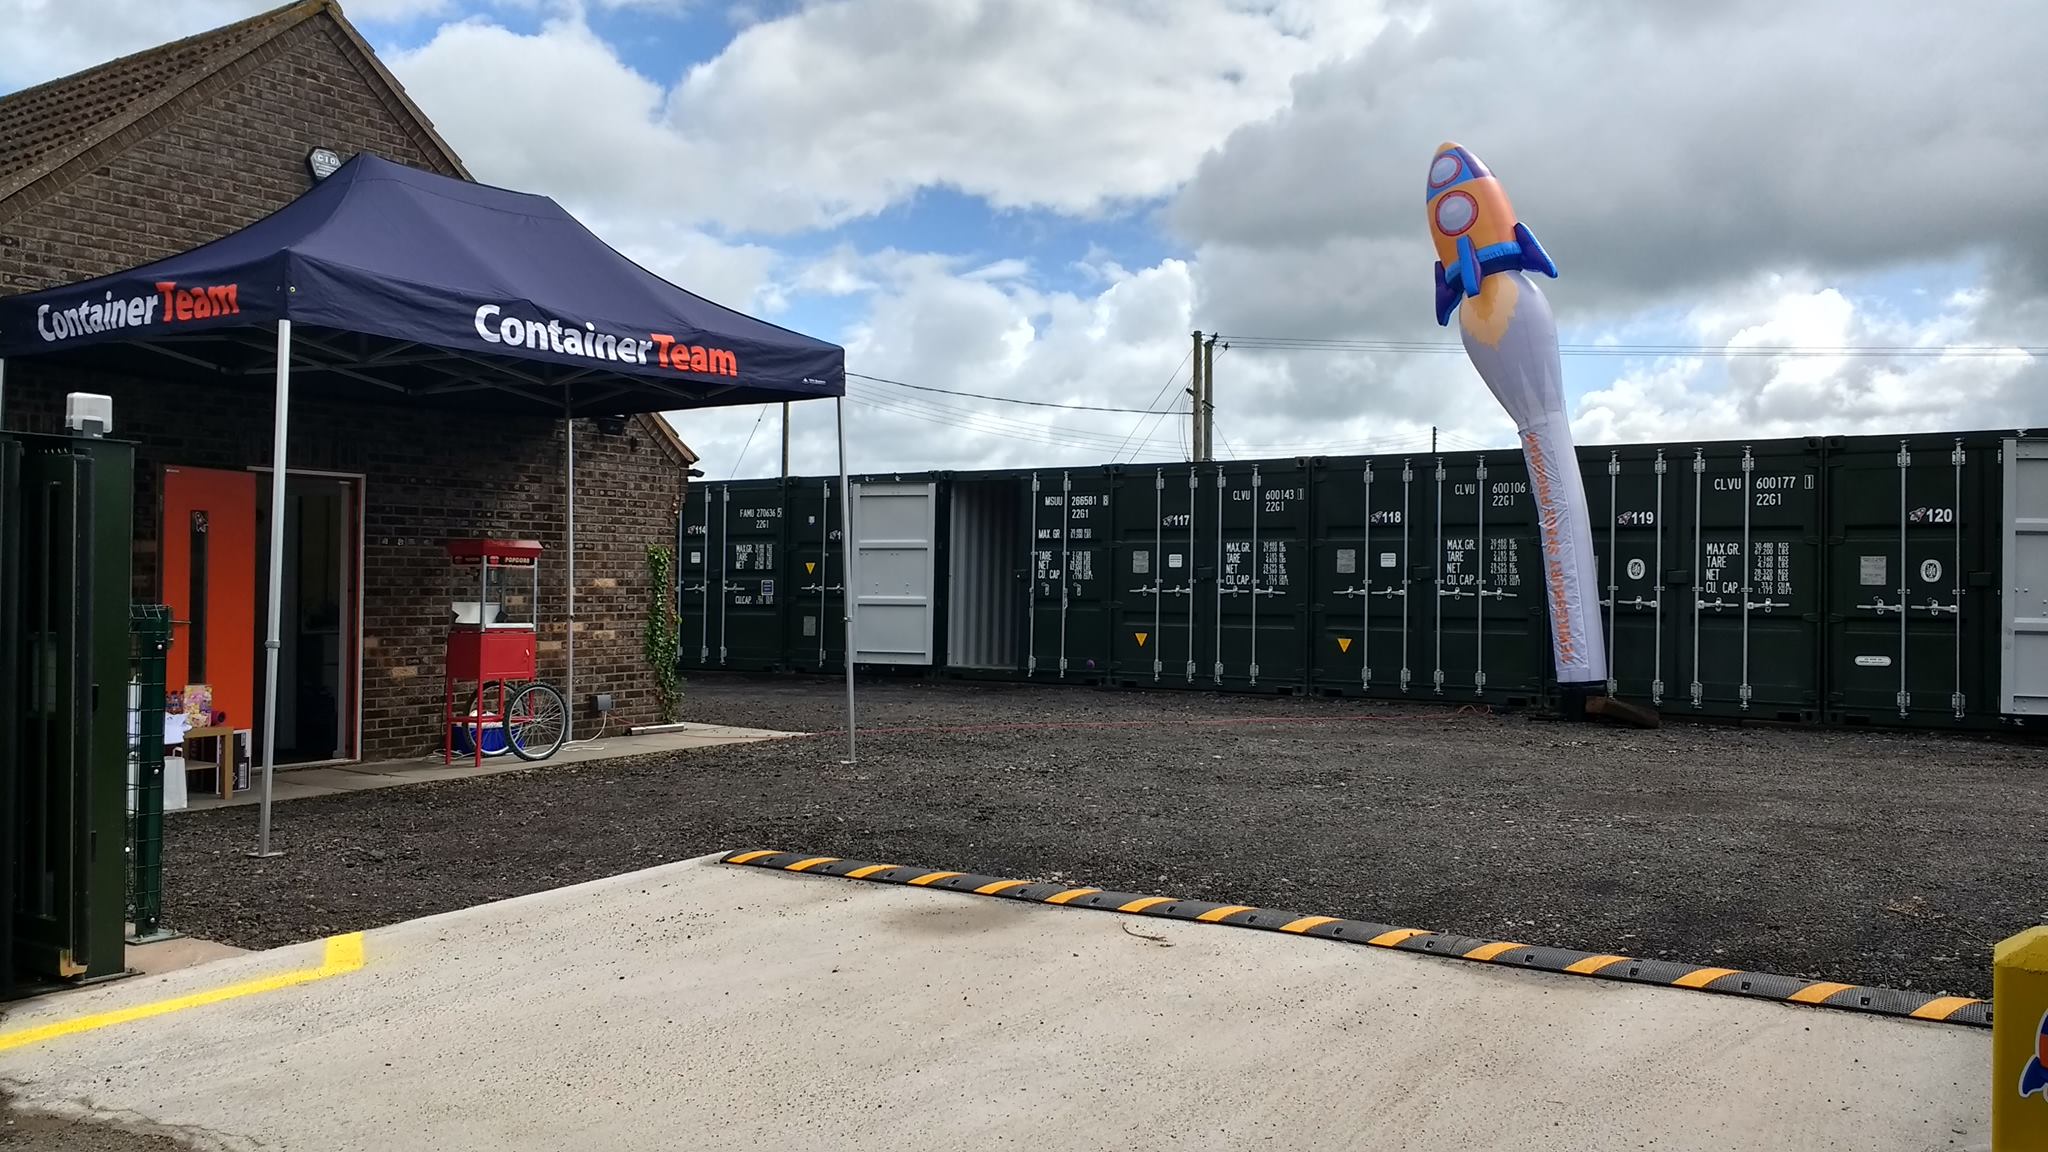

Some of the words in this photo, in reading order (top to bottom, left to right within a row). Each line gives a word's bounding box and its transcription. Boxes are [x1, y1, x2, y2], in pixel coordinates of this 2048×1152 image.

[38, 281, 240, 342] ContainerTeam
[474, 304, 737, 376] ContainerTeam
[1454, 484, 1476, 495] CLVU
[1492, 482, 1526, 494] 600106
[1714, 478, 1742, 490] CLVU
[1756, 476, 1796, 489] 600177
[1232, 490, 1251, 500] CLVU
[1266, 489, 1294, 500] 600143
[1756, 493, 1782, 506] 22G1
[1044, 496, 1063, 506] MSUU
[1072, 496, 1097, 506] 266581
[1492, 495, 1514, 506] 22G1
[1266, 501, 1284, 512] 22G1
[740, 509, 754, 518] FAMU
[756, 508, 776, 517] 270636
[1072, 509, 1089, 518] 22G1
[1382, 511, 1401, 523] 118
[1631, 511, 1654, 524] 119
[1926, 508, 1953, 522] 120
[1173, 515, 1190, 525] 117
[736, 553, 748, 561] TARE
[1039, 551, 1052, 560] TARE
[1227, 553, 1241, 563] TARE
[1447, 551, 1464, 561] TARE
[736, 561, 744, 569] NET
[1038, 560, 1049, 569] NET
[1706, 556, 1727, 568] TARE
[1226, 564, 1238, 574] NET
[1447, 562, 1460, 574] NET
[1706, 568, 1720, 580] NET
